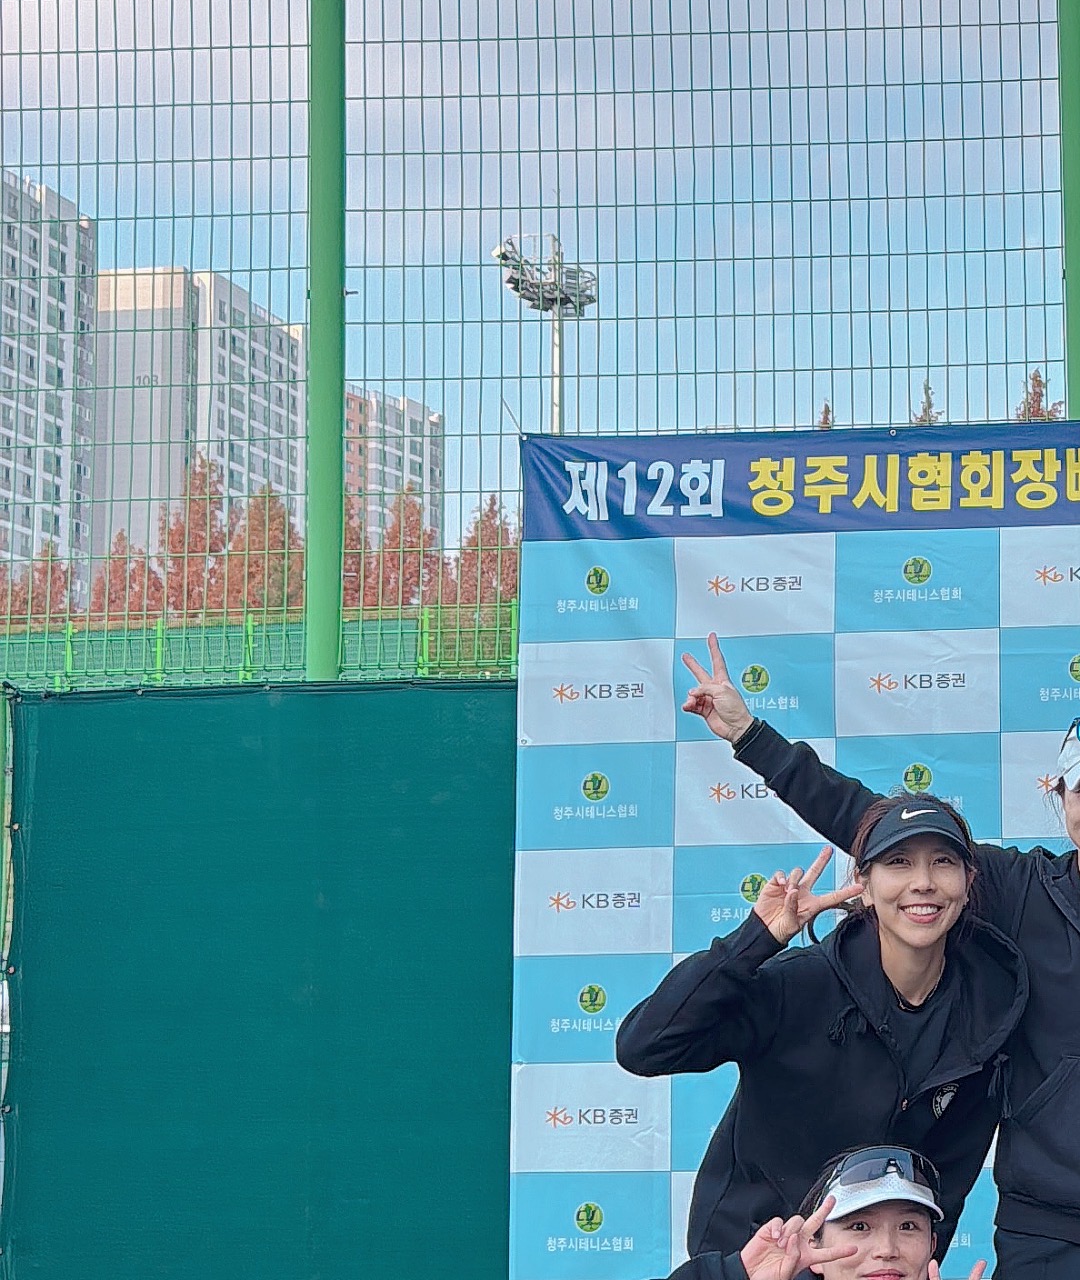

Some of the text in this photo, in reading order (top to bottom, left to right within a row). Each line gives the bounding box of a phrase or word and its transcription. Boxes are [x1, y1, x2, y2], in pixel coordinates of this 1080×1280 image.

[563, 458, 727, 521] 제12회
[741, 576, 801, 591] KB증권
[874, 588, 961, 603] 청주시테니스협회
[557, 598, 638, 613] 청주시테니스협회
[905, 674, 965, 689] KB증권
[585, 683, 643, 699] KB증권
[745, 696, 799, 710] 테니스협회
[554, 806, 637, 820] 청주시테니스협회
[582, 893, 640, 909] KB증권
[551, 1017, 623, 1033] 청주시테니스
[579, 1108, 638, 1124] KB증권
[547, 1237, 633, 1251] 청주시테니스협회
